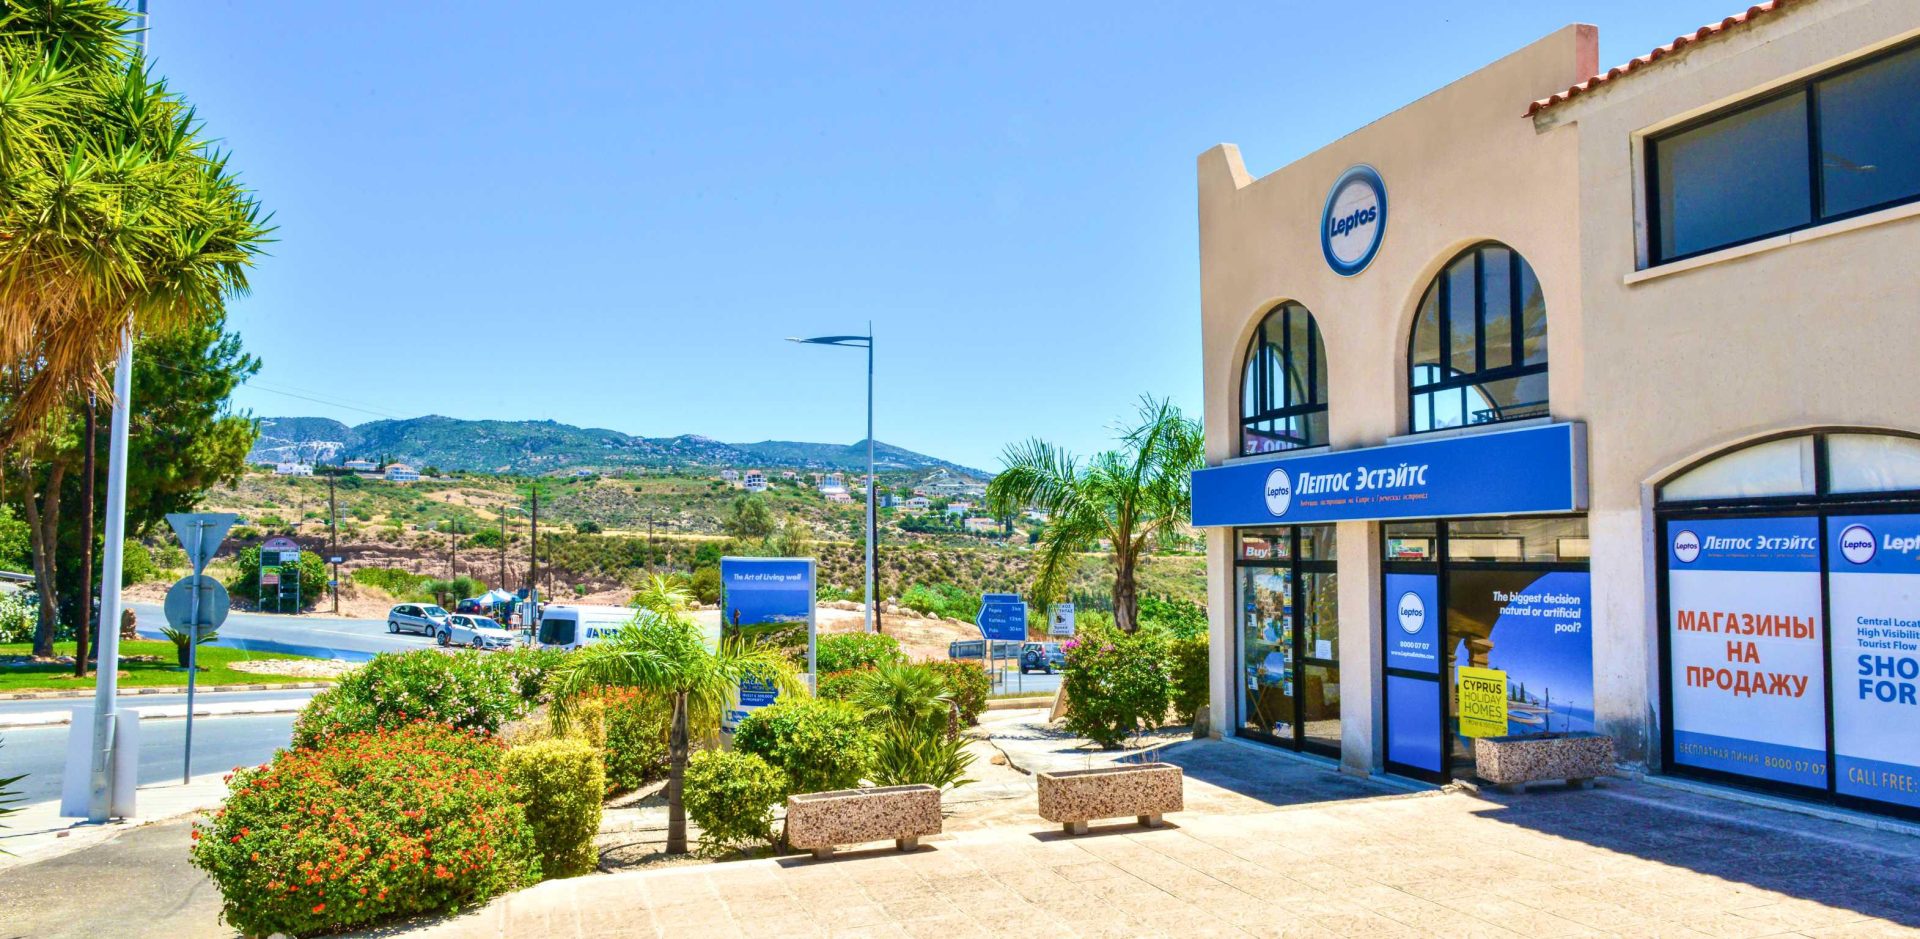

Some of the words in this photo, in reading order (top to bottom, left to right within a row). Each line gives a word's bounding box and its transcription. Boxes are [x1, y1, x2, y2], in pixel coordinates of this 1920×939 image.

[1331, 206, 1377, 237] Leptos
[1267, 486, 1289, 498] Leptos
[1676, 542, 1698, 551] Leptos
[1844, 540, 1872, 550] Leptos
[1245, 546, 1268, 559] Buy
[734, 573, 743, 581] The
[744, 573, 755, 581] Art
[755, 573, 763, 581] of
[763, 573, 785, 583] Living
[786, 573, 802, 581] well
[1493, 591, 1509, 602] The
[1509, 591, 1542, 605] biggest
[1543, 593, 1581, 605] decision
[1401, 607, 1423, 618] Leptos
[1500, 605, 1531, 616] natural
[1531, 608, 1542, 617] or
[1543, 608, 1582, 619] artificial
[1554, 621, 1582, 634] pool?
[1677, 610, 1815, 640] МАГАЗИНЫ
[1857, 616, 1892, 627] Central
[1857, 628, 1880, 639] High
[1400, 640, 1415, 649] 8000
[1857, 639, 1891, 649] Tourist
[1893, 641, 1918, 651] Flow
[1727, 640, 1761, 665] НА
[1858, 654, 1919, 680] SHO
[1463, 680, 1502, 694] CYPRUS
[1686, 666, 1809, 698] ПРОДАЖУ
[1464, 691, 1502, 705] HOLIDAY
[1859, 679, 1917, 706] FOR
[1464, 702, 1502, 719] HOMES
[1679, 742, 1729, 760] БЕСПЛАТНАЯ
[1731, 750, 1759, 764] ЛИНИЯ
[1764, 755, 1792, 770] 8000
[1794, 760, 1809, 773] 07
[1811, 763, 1826, 776] 07
[1848, 767, 1878, 788] CALL
[1881, 772, 1918, 793] FREE:
